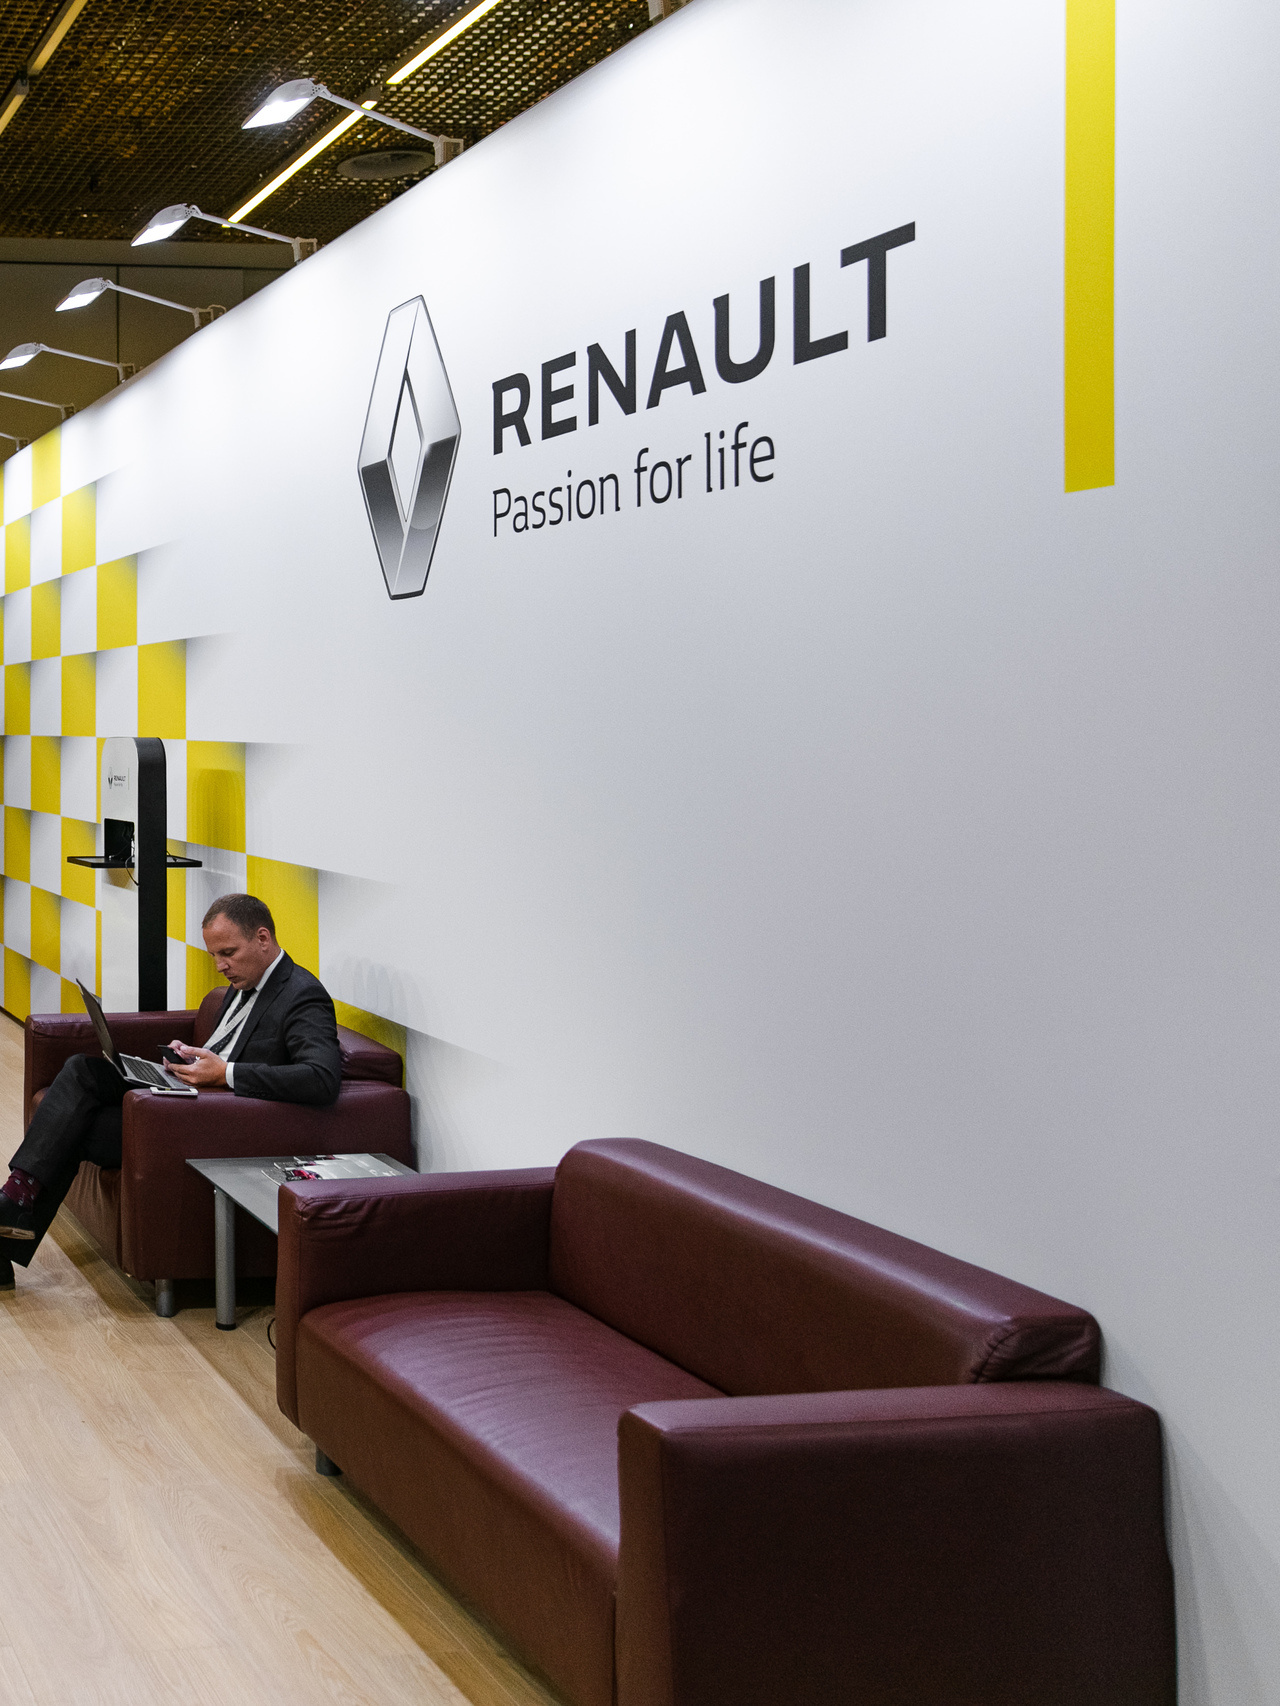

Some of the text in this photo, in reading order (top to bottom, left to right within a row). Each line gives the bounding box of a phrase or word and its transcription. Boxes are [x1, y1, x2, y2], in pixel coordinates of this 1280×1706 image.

[491, 221, 916, 456] RENAULT
[492, 421, 776, 538] Passion for life
